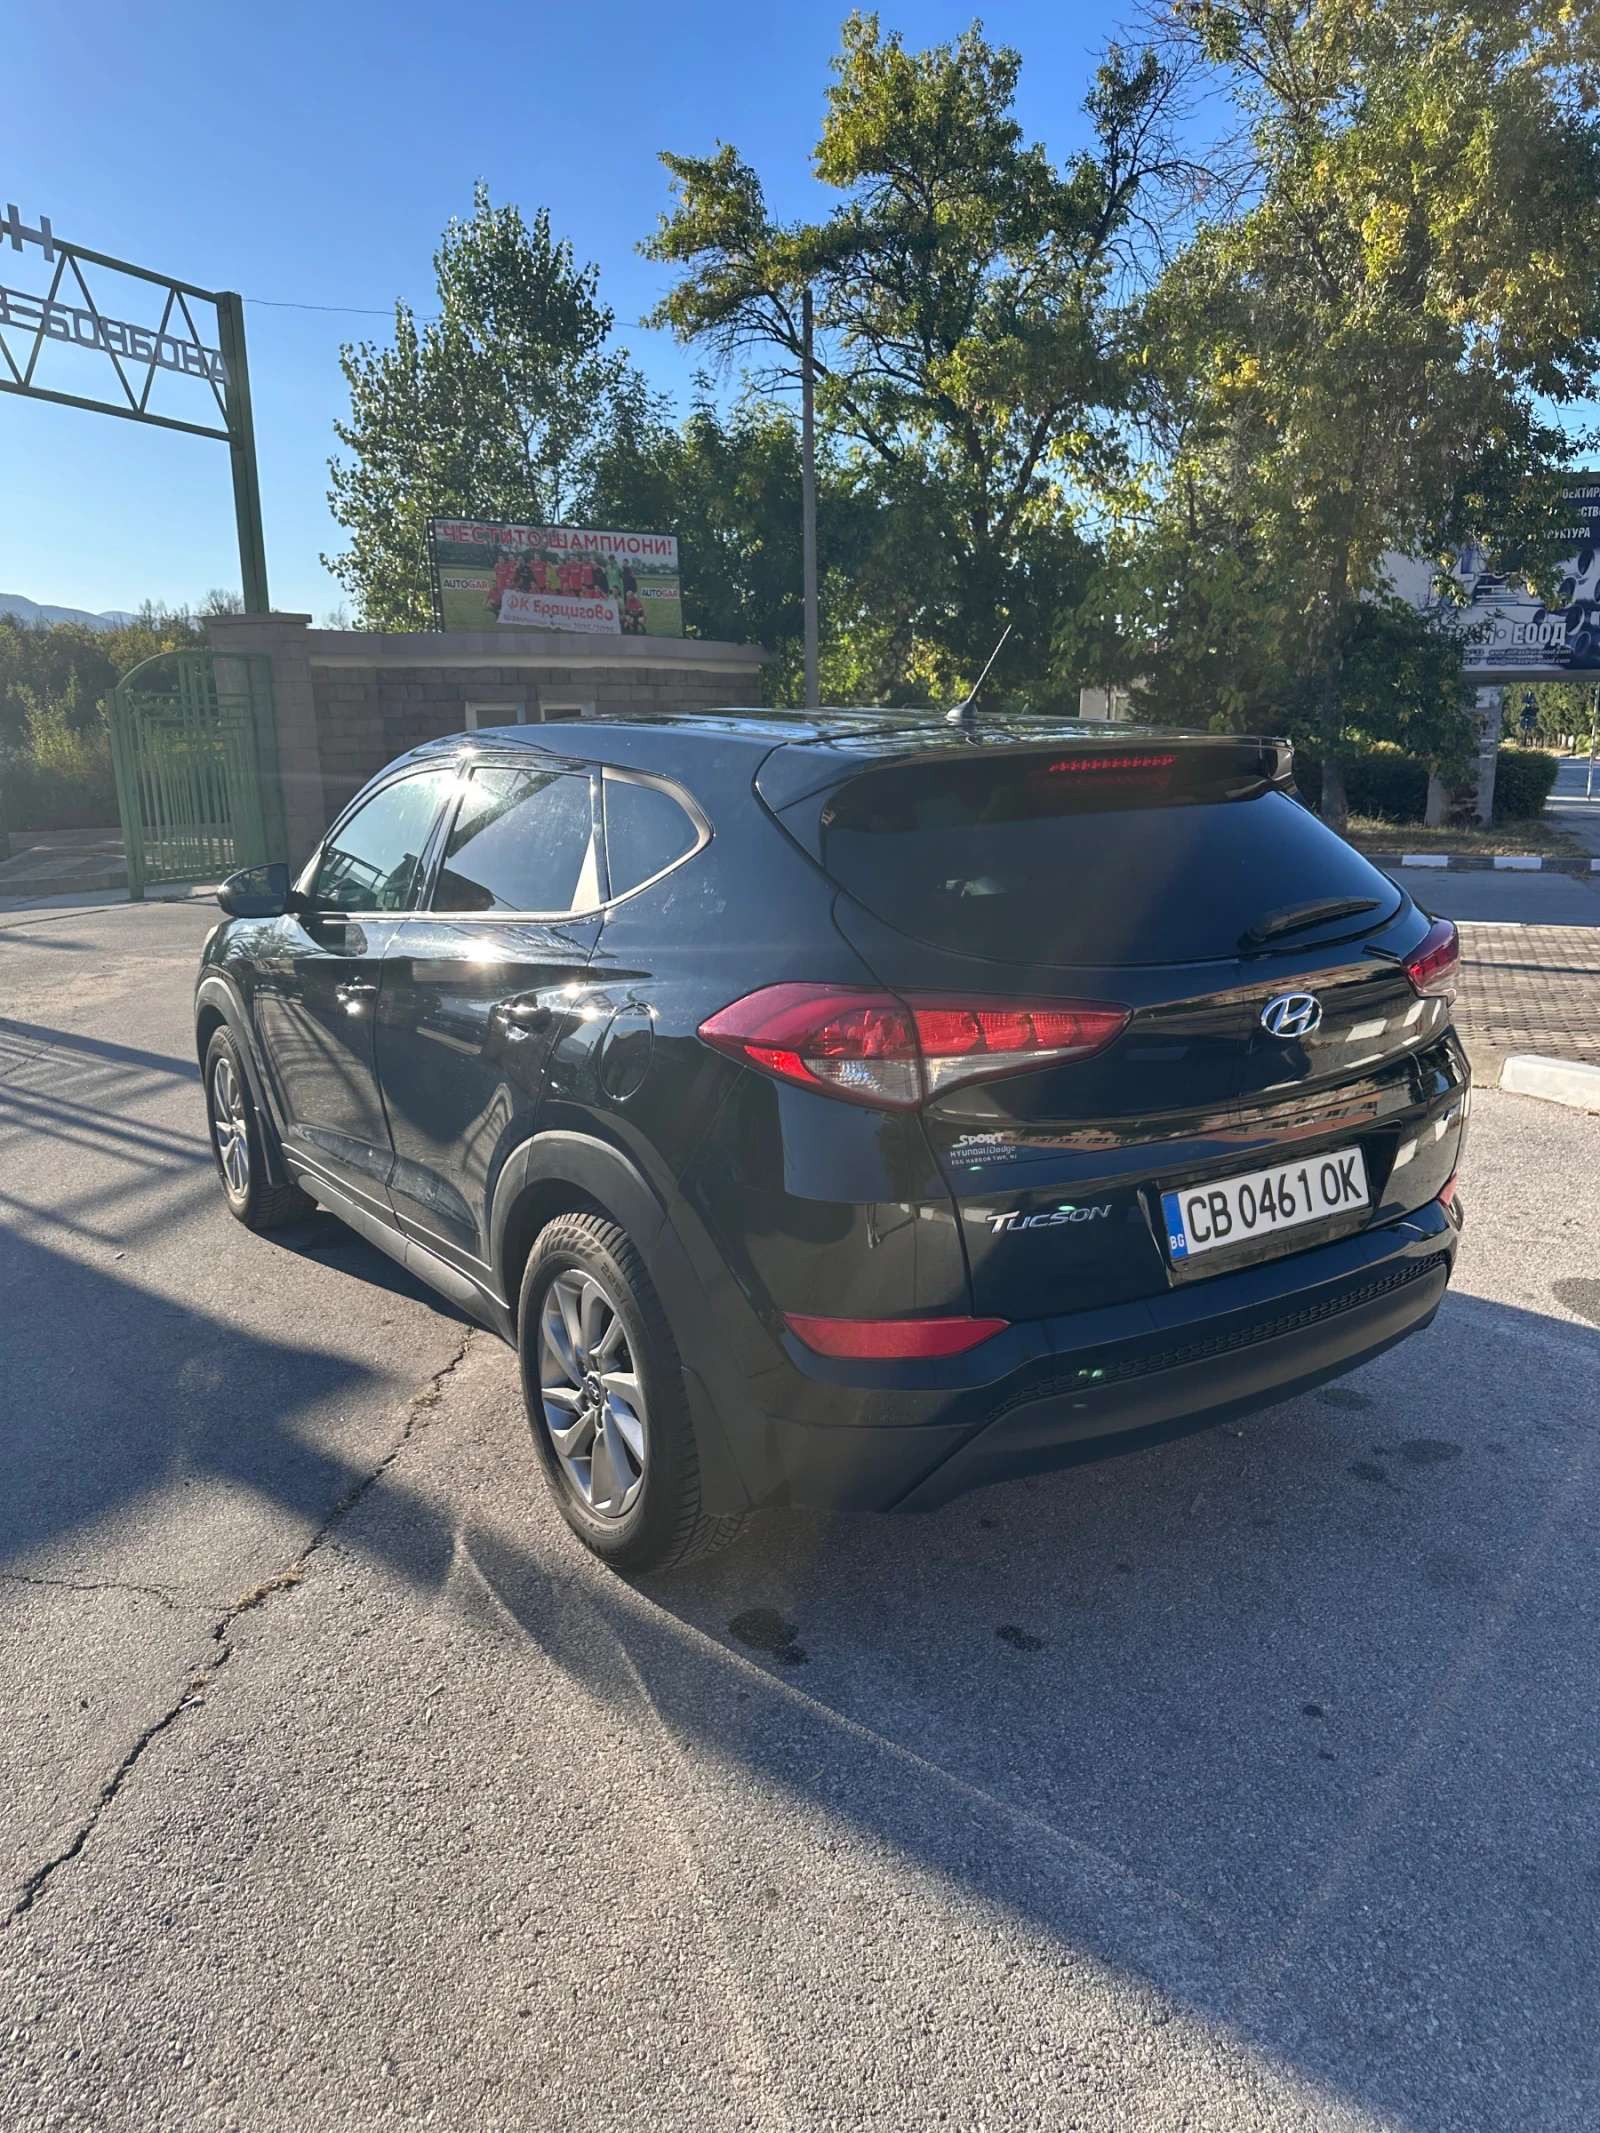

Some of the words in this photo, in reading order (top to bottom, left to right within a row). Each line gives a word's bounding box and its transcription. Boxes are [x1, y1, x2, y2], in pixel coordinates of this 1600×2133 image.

[0, 202, 55, 263] Н
[443, 523, 543, 548] ЧЕСТИТО
[548, 532, 672, 556] ШАМПИОНИ!
[443, 579, 489, 590] AUTOGAR
[641, 588, 678, 598] AUTOGAR
[508, 594, 530, 611] ФК
[533, 599, 614, 621] Брацигово
[1512, 622, 1567, 647] ЕООД
[1489, 648, 1571, 656] www.infrastroi-eood.com
[959, 1132, 1004, 1147] SPORT
[965, 1156, 991, 1164] HARBOR
[1187, 1190, 1233, 1243] CB
[1238, 1168, 1313, 1229] 0461
[1320, 1155, 1363, 1206] OK
[1169, 1232, 1185, 1250] BG
